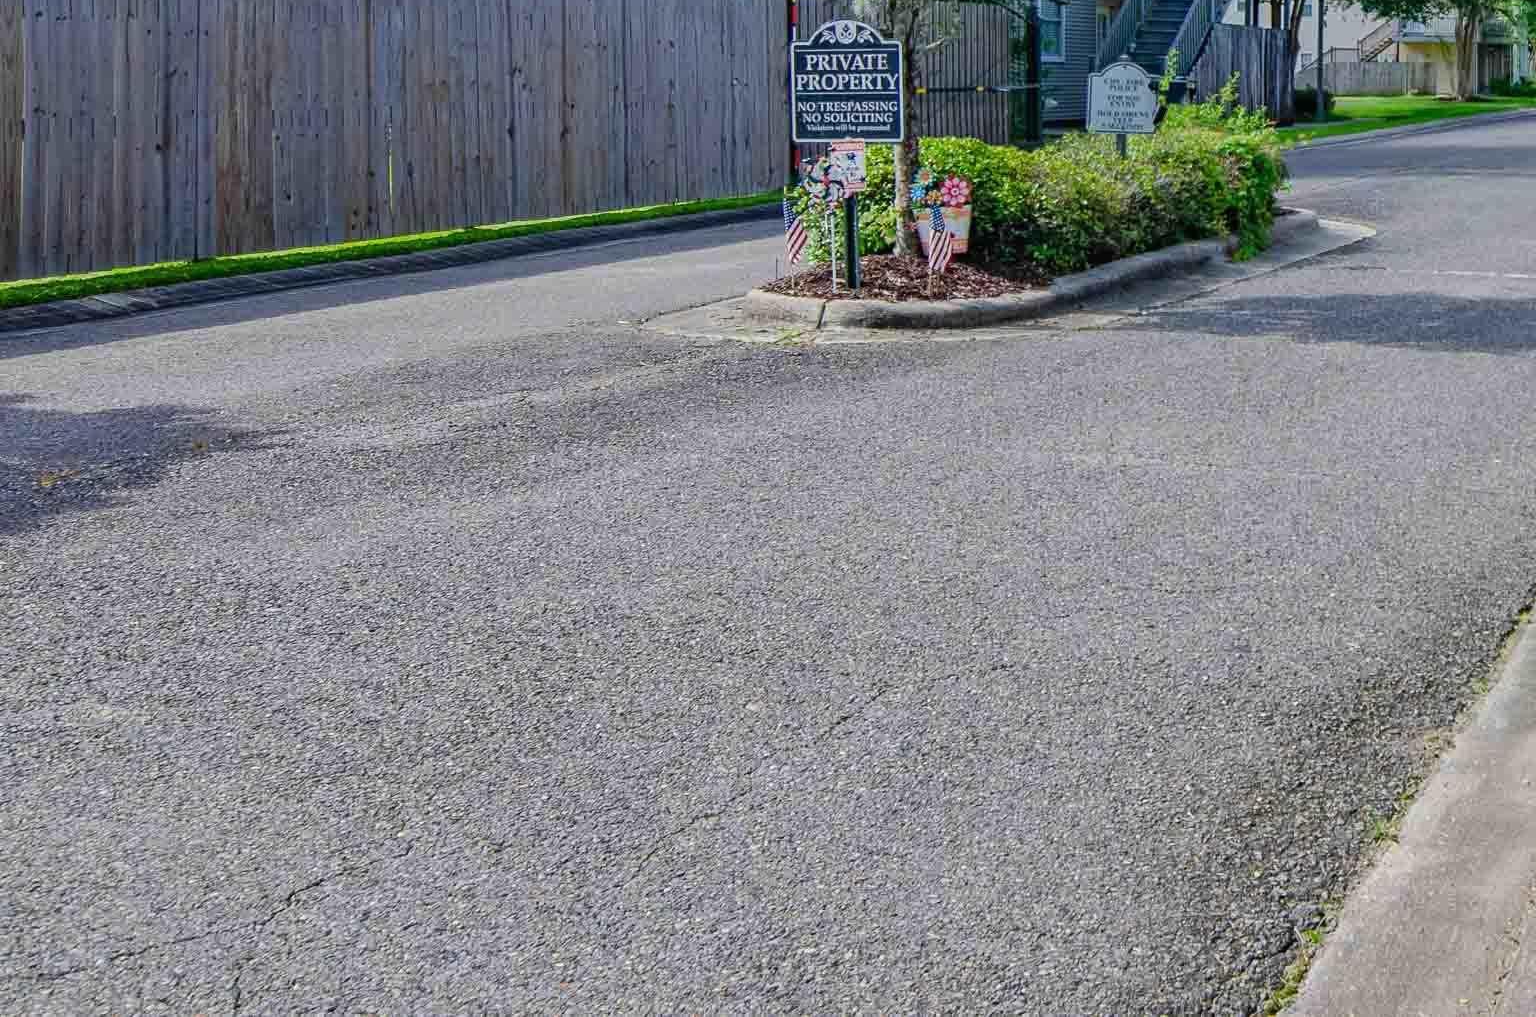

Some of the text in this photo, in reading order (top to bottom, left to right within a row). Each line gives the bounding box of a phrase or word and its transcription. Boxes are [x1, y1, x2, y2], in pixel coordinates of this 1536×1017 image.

[806, 53, 888, 70] PRIVATE
[796, 74, 898, 90] PROPERTY
[798, 102, 898, 112] NO TRESPASSING
[802, 113, 894, 123] NO SOLICITING
